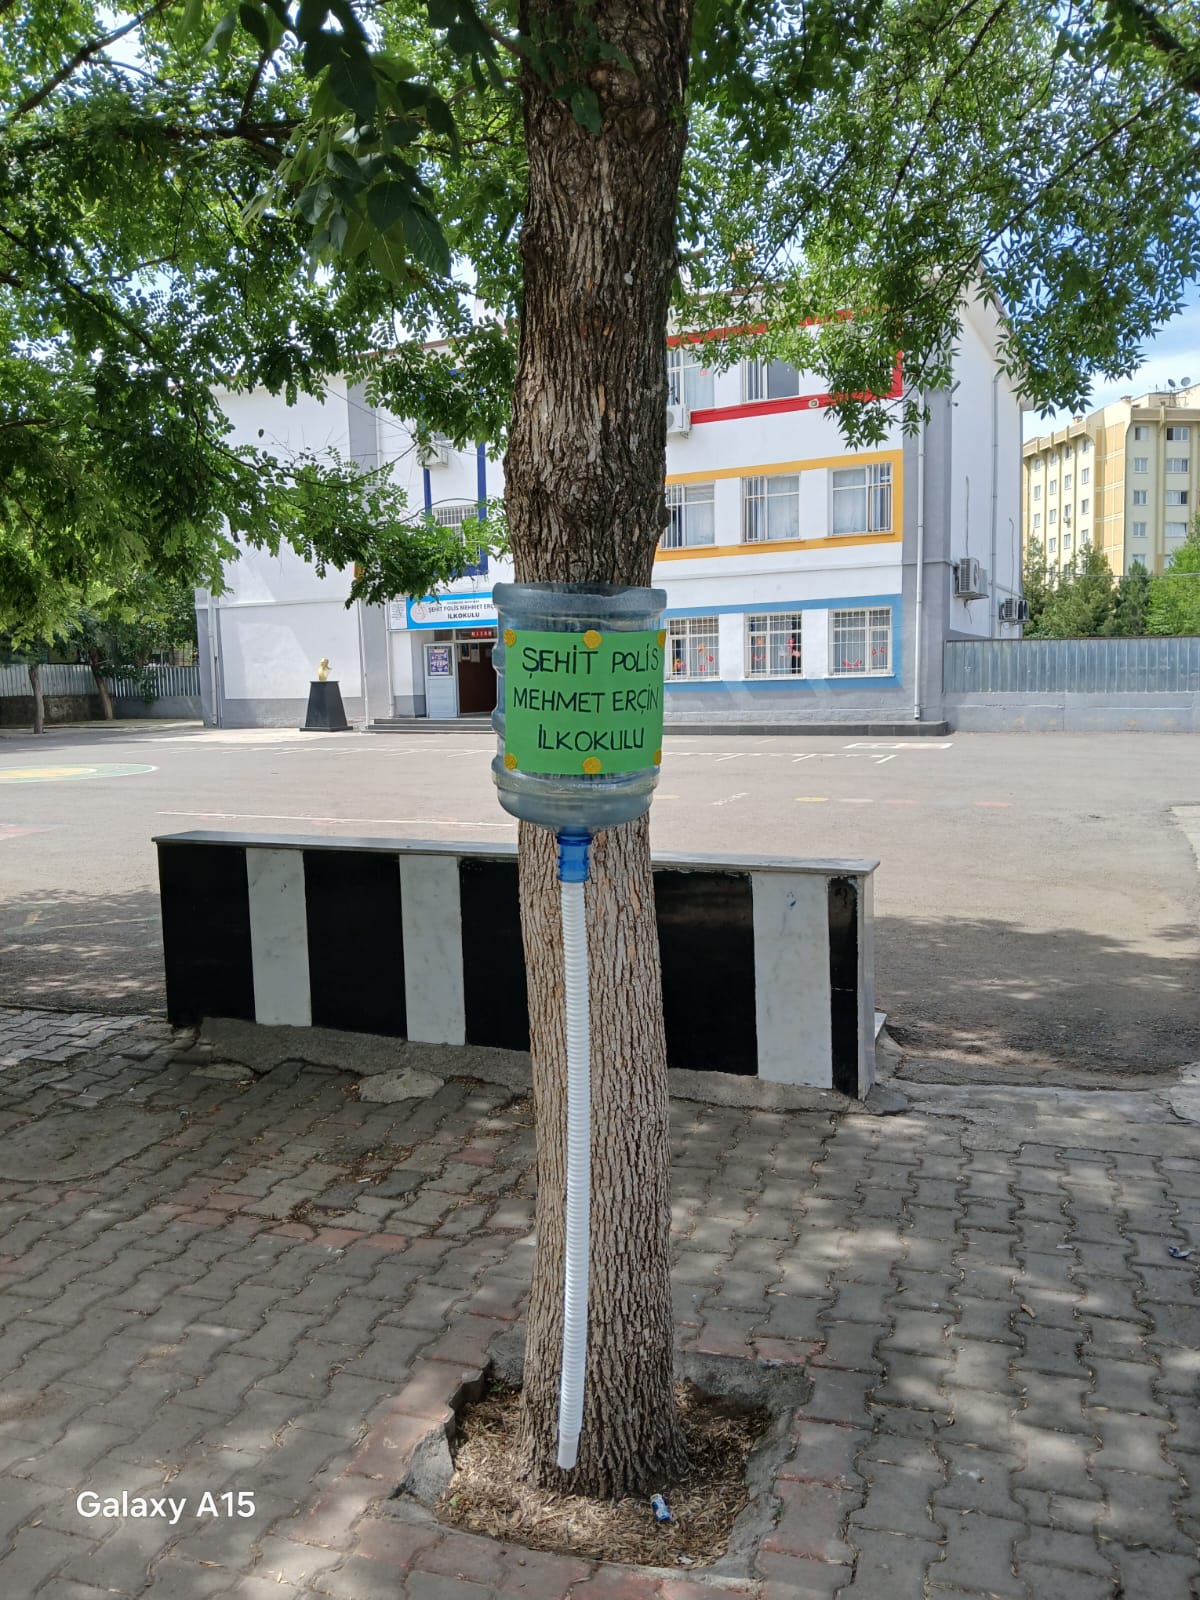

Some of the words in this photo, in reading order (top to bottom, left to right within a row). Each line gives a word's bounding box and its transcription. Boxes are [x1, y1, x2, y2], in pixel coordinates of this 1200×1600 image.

[522, 645, 599, 679] ŞEHİT
[612, 643, 659, 674] POLİS
[513, 687, 606, 713] MEHMET
[612, 683, 660, 715] ERÇİN
